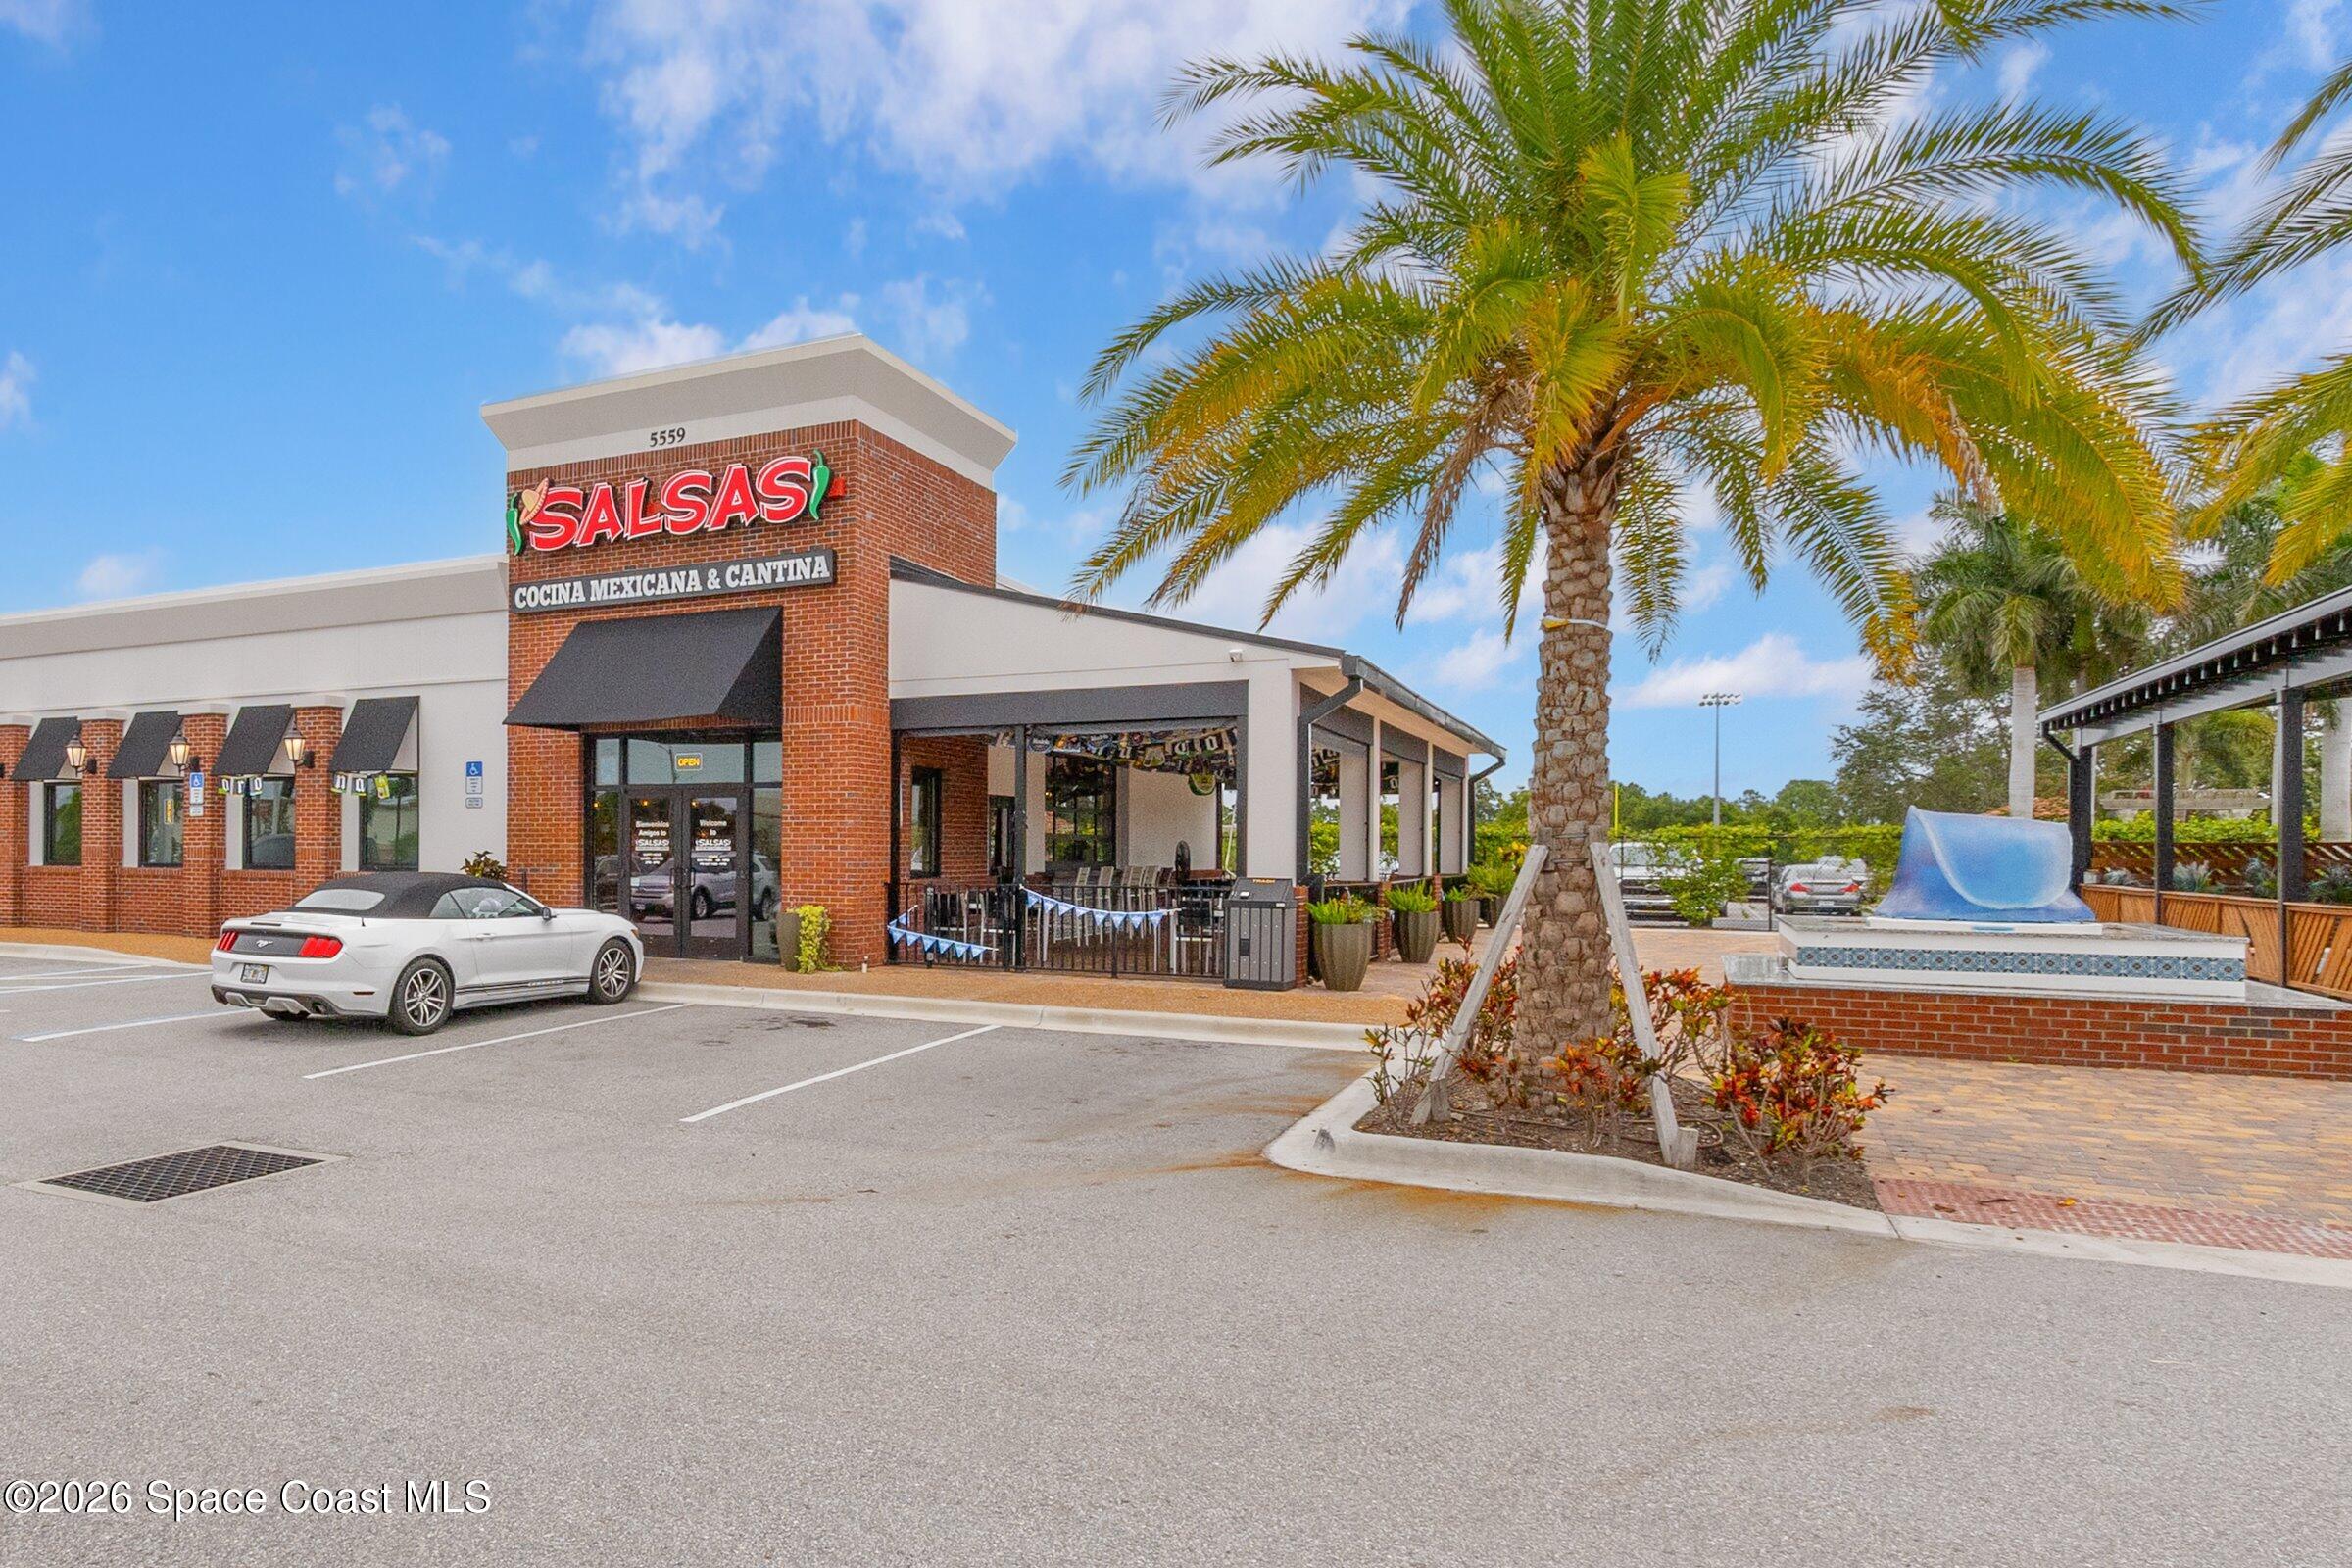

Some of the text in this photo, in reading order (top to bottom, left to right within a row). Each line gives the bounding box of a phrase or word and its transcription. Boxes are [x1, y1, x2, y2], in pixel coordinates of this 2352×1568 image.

[649, 426, 686, 448] 5559
[527, 455, 812, 552] SALSAS
[514, 554, 830, 610] COCINA MEXICANA & CANTINA
[677, 758, 701, 767] OPEN
[638, 829, 660, 838] Amigos
[637, 838, 669, 847] SALSAS
[697, 838, 730, 847] SALSAS
